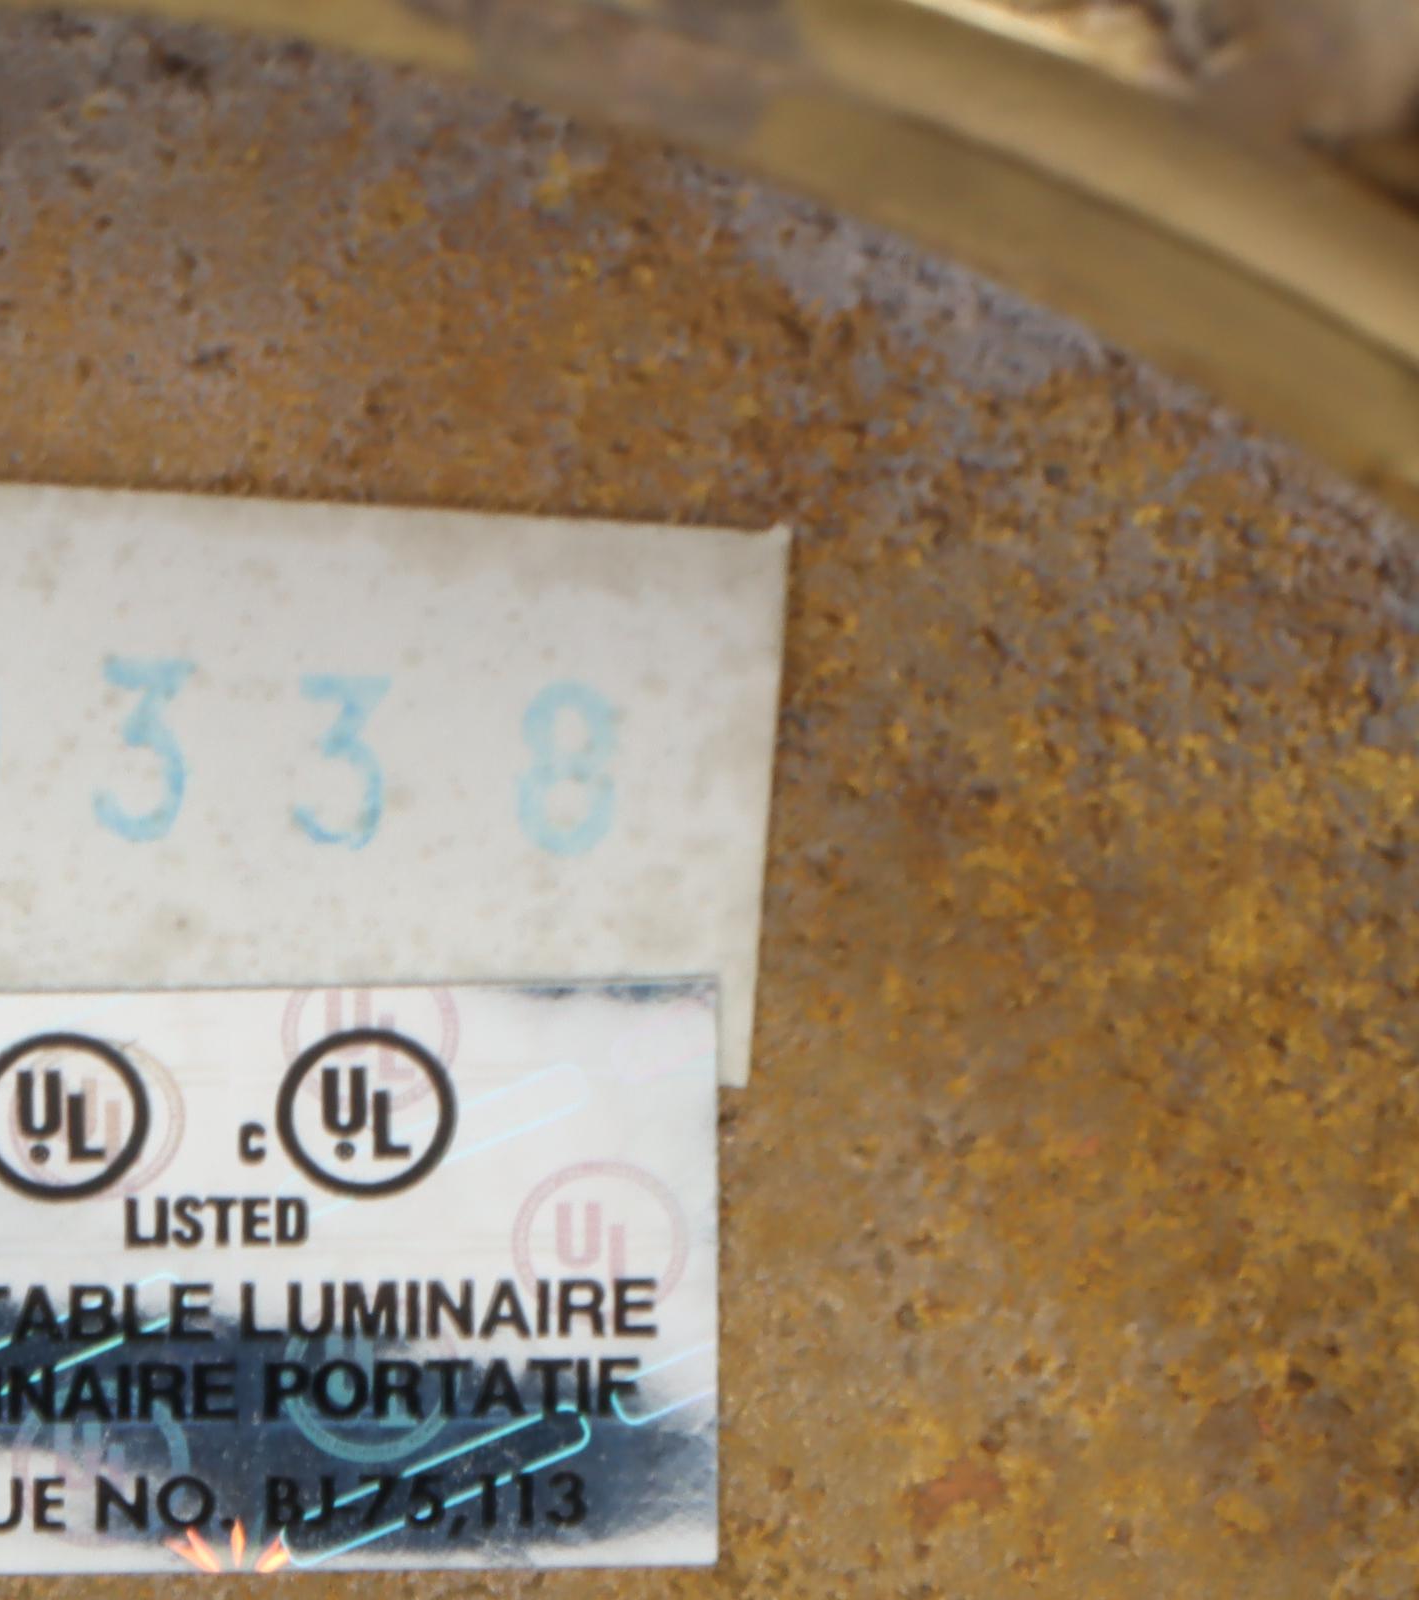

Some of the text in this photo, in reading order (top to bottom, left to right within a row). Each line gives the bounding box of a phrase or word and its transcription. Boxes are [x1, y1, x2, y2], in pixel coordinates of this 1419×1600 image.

[124, 1195, 308, 1250] LISTED
[240, 1276, 658, 1342] LUMINAIRE
[263, 1356, 641, 1420] PORTATIF
[93, 1474, 238, 1536] NO.
